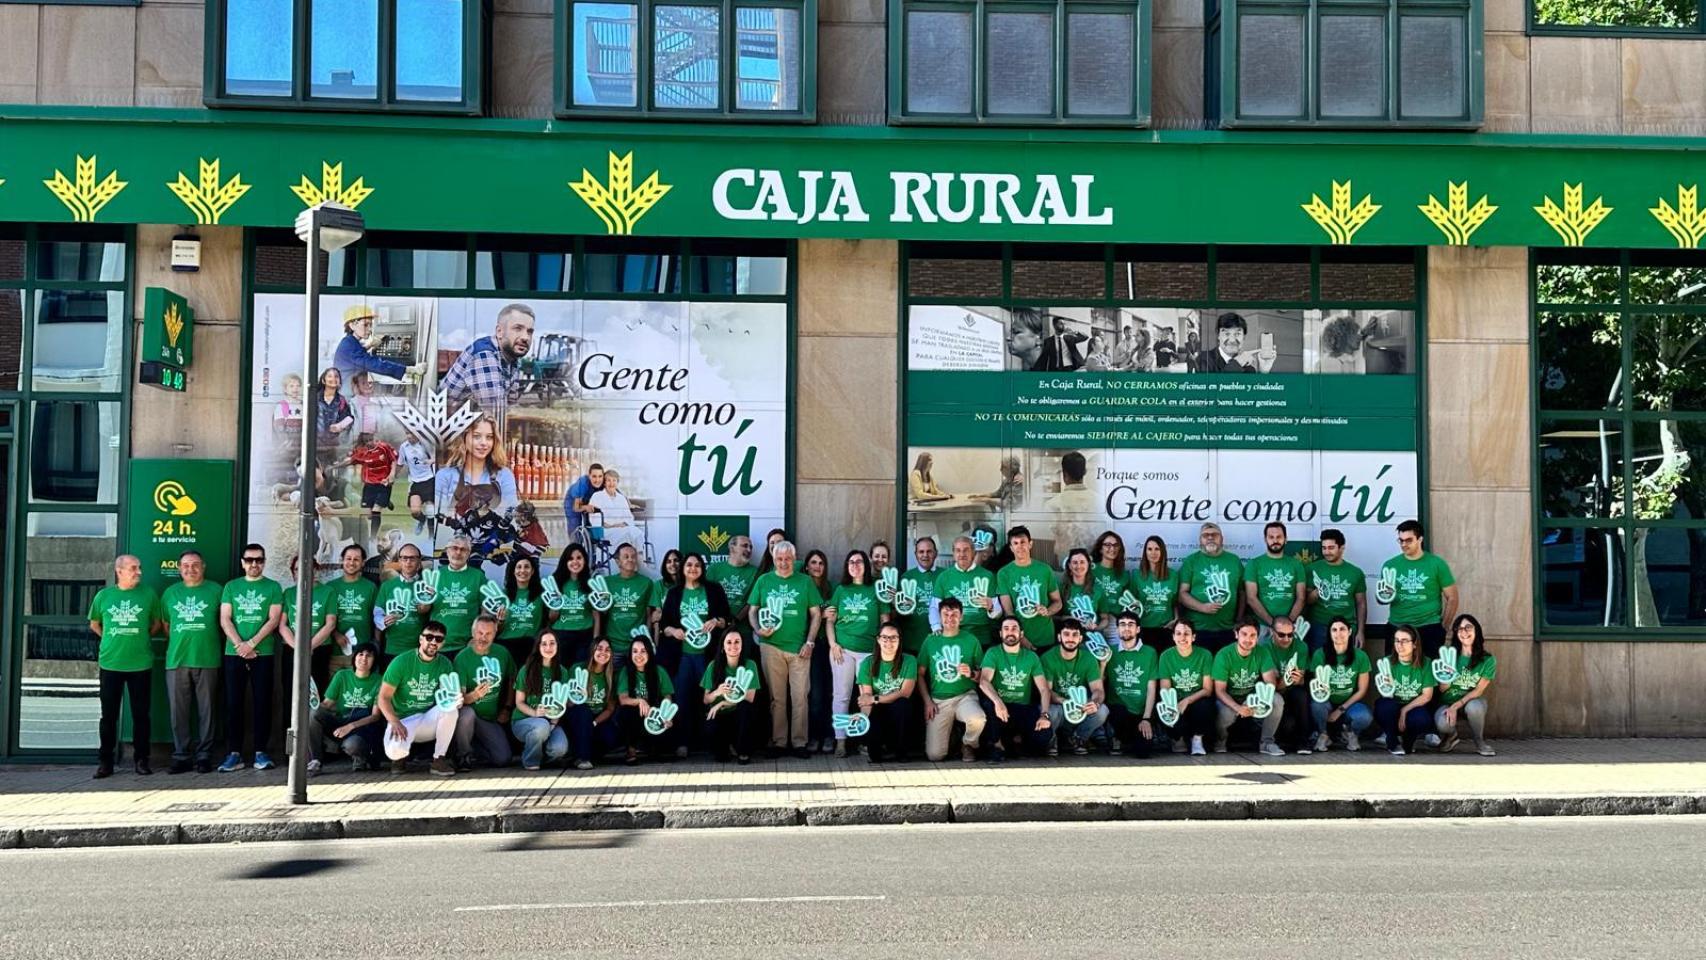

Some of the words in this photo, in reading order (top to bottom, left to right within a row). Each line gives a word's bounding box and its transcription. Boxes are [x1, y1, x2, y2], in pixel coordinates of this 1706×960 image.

[712, 168, 870, 225] CAJA
[889, 172, 1114, 225] RURAL
[578, 353, 689, 392] Gente
[1039, 380, 1049, 388] En
[1052, 379, 1074, 390] Caja
[1076, 379, 1103, 390] Rural,
[1107, 381, 1122, 389] NO
[1124, 381, 1178, 390] CERRAMOS
[1178, 382, 1206, 390] oficinas
[1220, 382, 1246, 391] pueblos
[1254, 382, 1284, 390] ciudades
[1018, 396, 1028, 404] No
[1039, 396, 1080, 406] obligaremos
[1140, 397, 1166, 405] COLA
[1179, 398, 1185, 406] el
[1187, 398, 1214, 406] exterior
[1234, 398, 1254, 406] hacer
[1256, 398, 1286, 408] gestiones
[638, 402, 736, 425] como
[1007, 412, 1080, 422] COMUNICARÁS
[1248, 416, 1293, 424] impersonales
[1024, 432, 1036, 440] No
[1087, 432, 1129, 440] SIEMPRE
[1130, 432, 1144, 440] AL
[1146, 432, 1182, 441] CAJERO
[1184, 434, 1201, 442] para
[1224, 432, 1242, 440] todas
[1257, 434, 1298, 442] operaciones
[678, 418, 763, 496] tú
[1096, 467, 1140, 483] Porque
[1142, 471, 1180, 481] somos
[1106, 485, 1212, 521] Gente
[1223, 500, 1317, 522] como
[1329, 464, 1396, 523] tú
[153, 520, 174, 535] 24
[180, 520, 196, 535] h.
